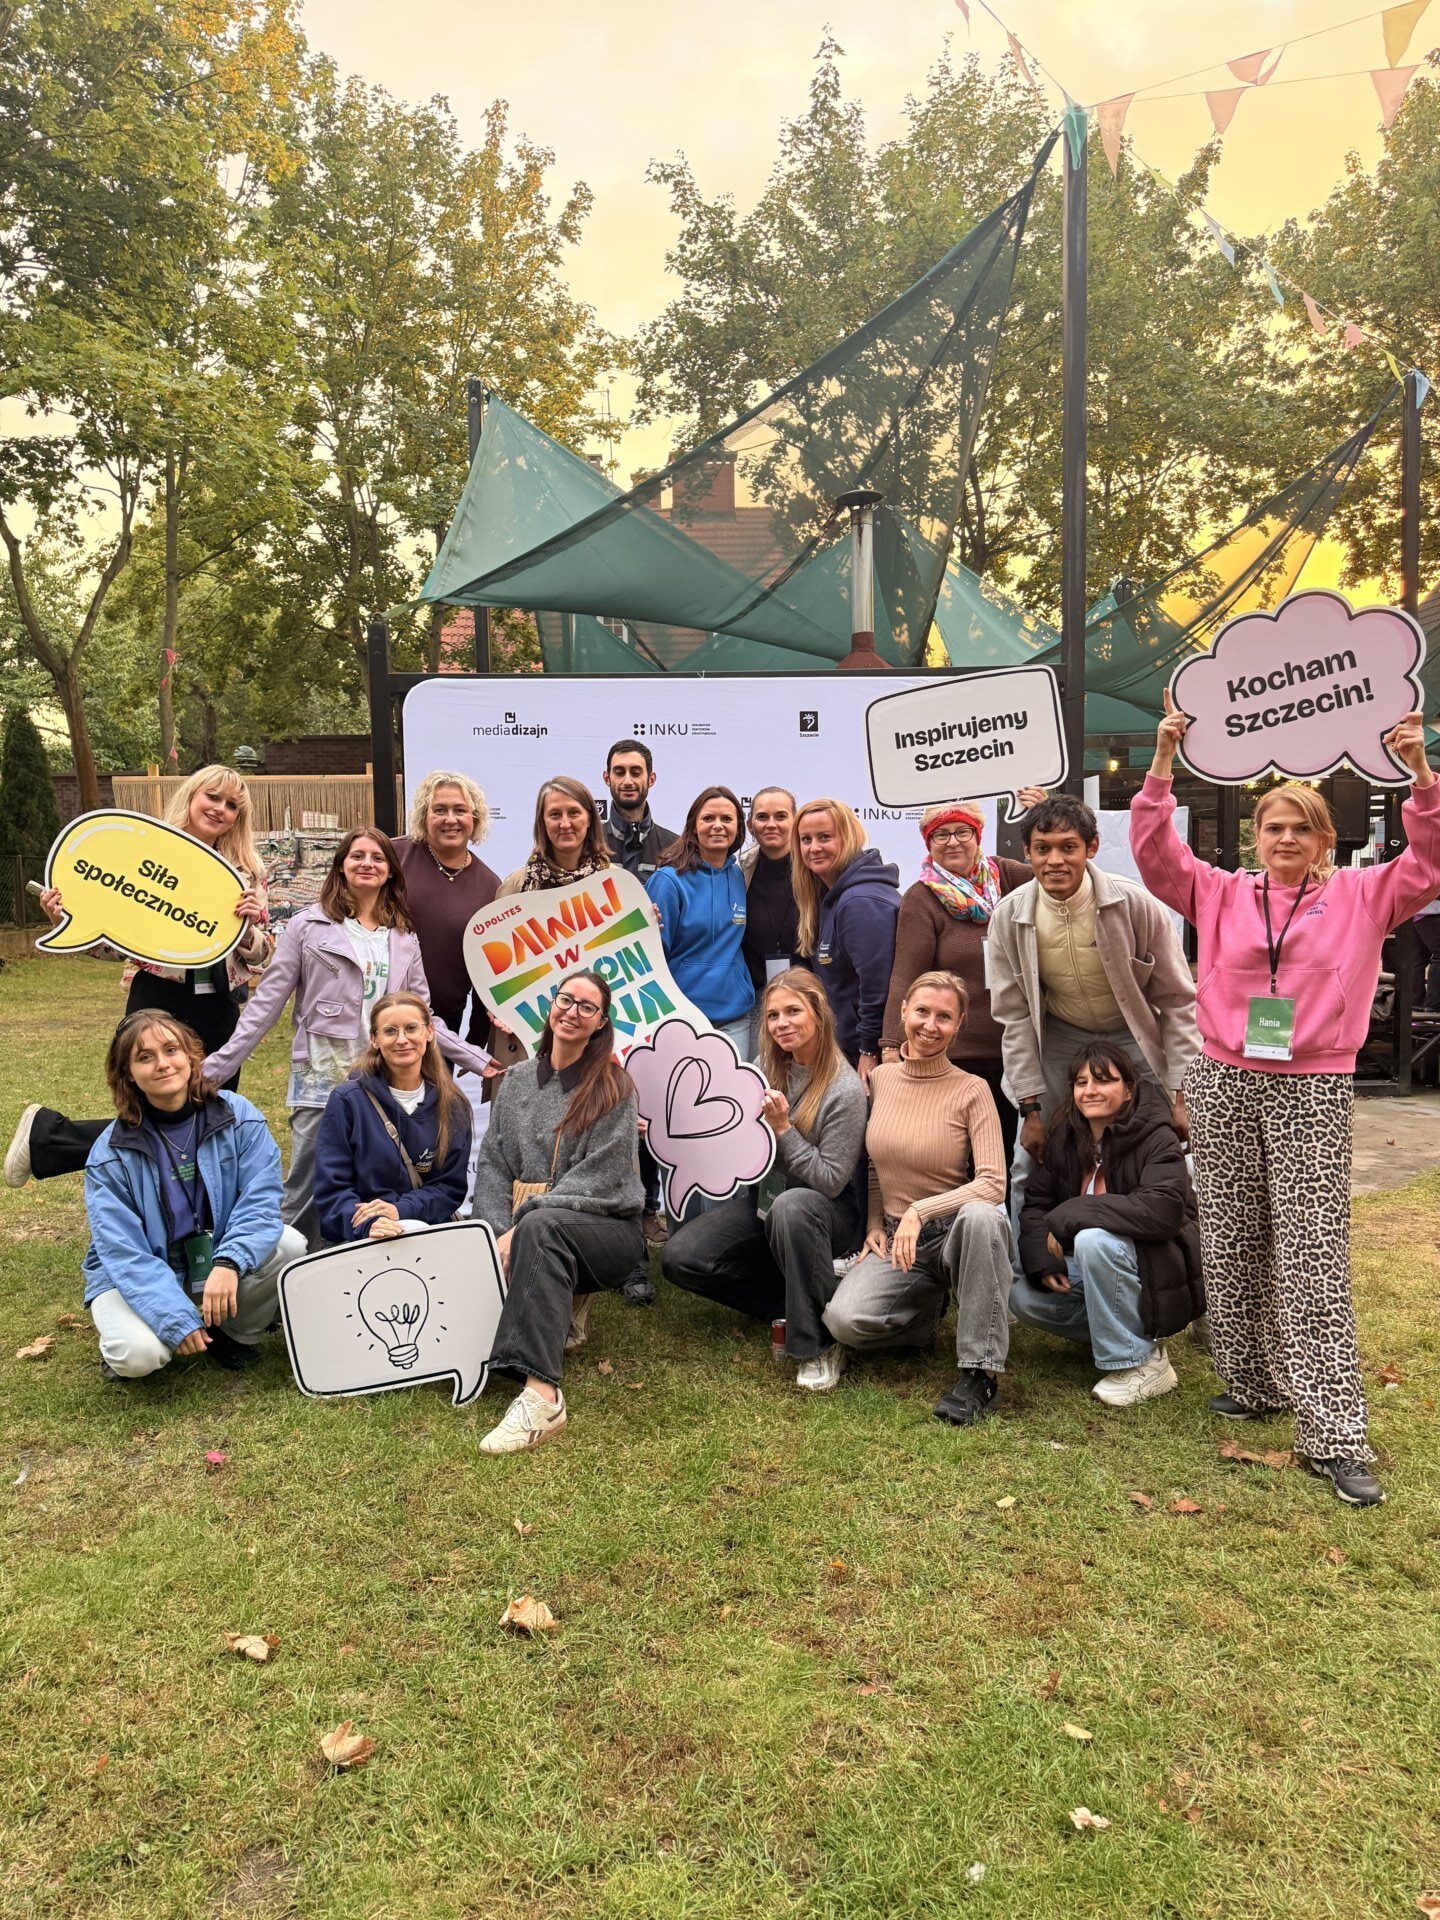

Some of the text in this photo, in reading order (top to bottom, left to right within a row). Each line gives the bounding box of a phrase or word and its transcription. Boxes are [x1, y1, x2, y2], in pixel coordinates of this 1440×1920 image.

[1226, 649, 1357, 703] Kocham
[1224, 677, 1375, 737] Szczecin!
[473, 724, 548, 739] mediadizajn
[649, 723, 688, 736] INKU
[894, 710, 1028, 750] Inspirujemy
[914, 738, 1014, 772] Szczecin
[863, 808, 902, 820] INKU
[137, 859, 179, 891] Siła
[73, 859, 219, 938] społeczności
[481, 877, 623, 976] DAWAJ
[484, 904, 522, 929] POLITES
[1259, 1016, 1281, 1028] Hania
